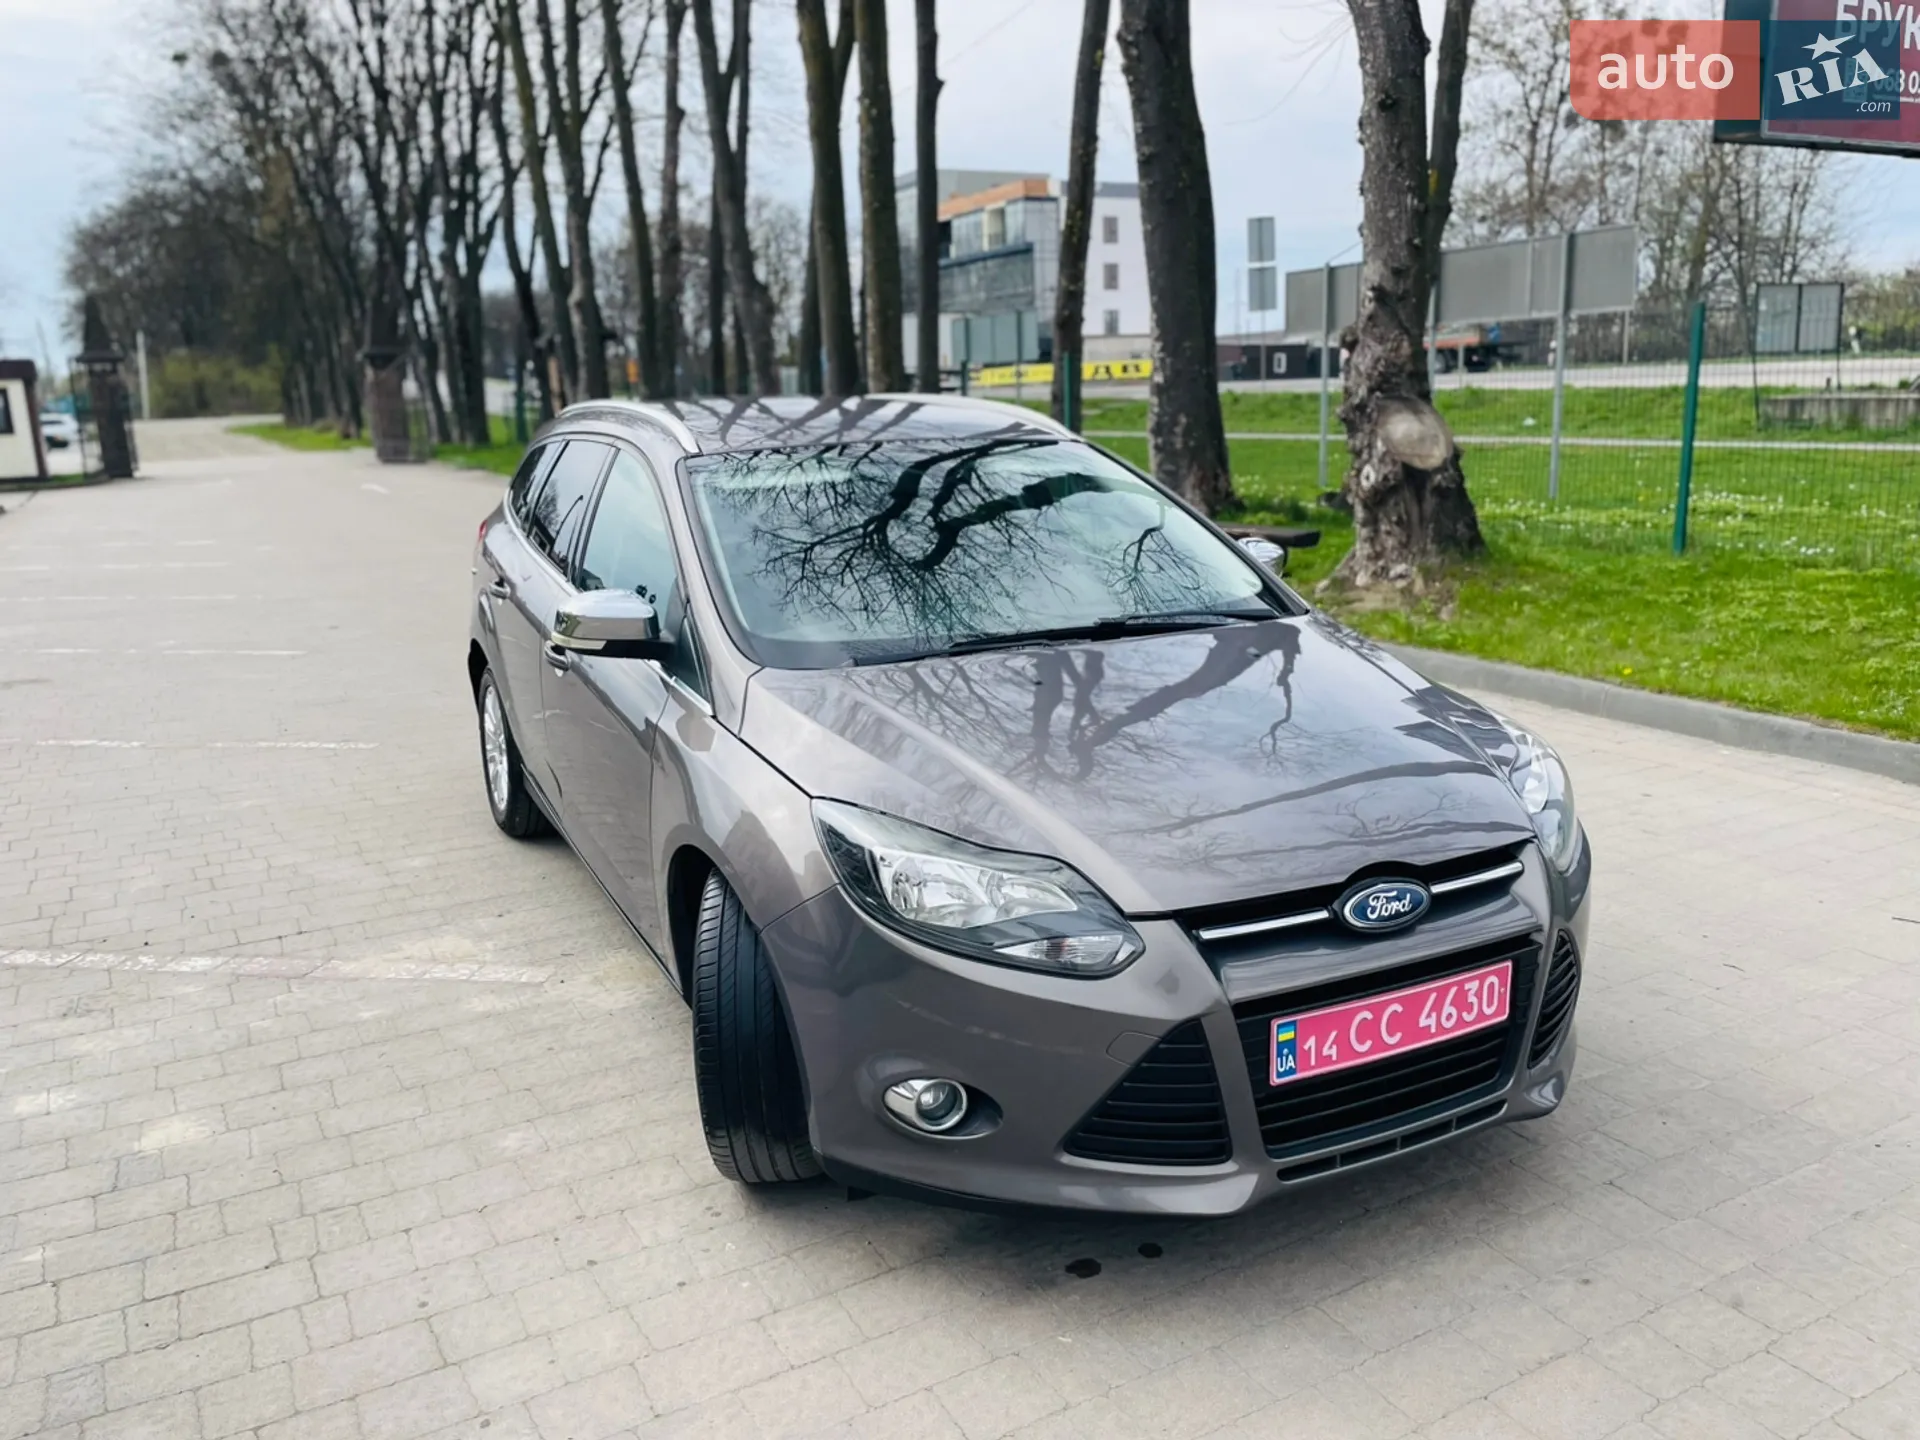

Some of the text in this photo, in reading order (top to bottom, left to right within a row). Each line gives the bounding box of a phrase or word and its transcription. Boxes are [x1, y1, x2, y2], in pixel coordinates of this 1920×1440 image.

[1367, 890, 1412, 919] Ford
[1303, 1030, 1338, 1066] 14
[1419, 975, 1499, 1034] 4630
[1277, 1054, 1296, 1072] UA
